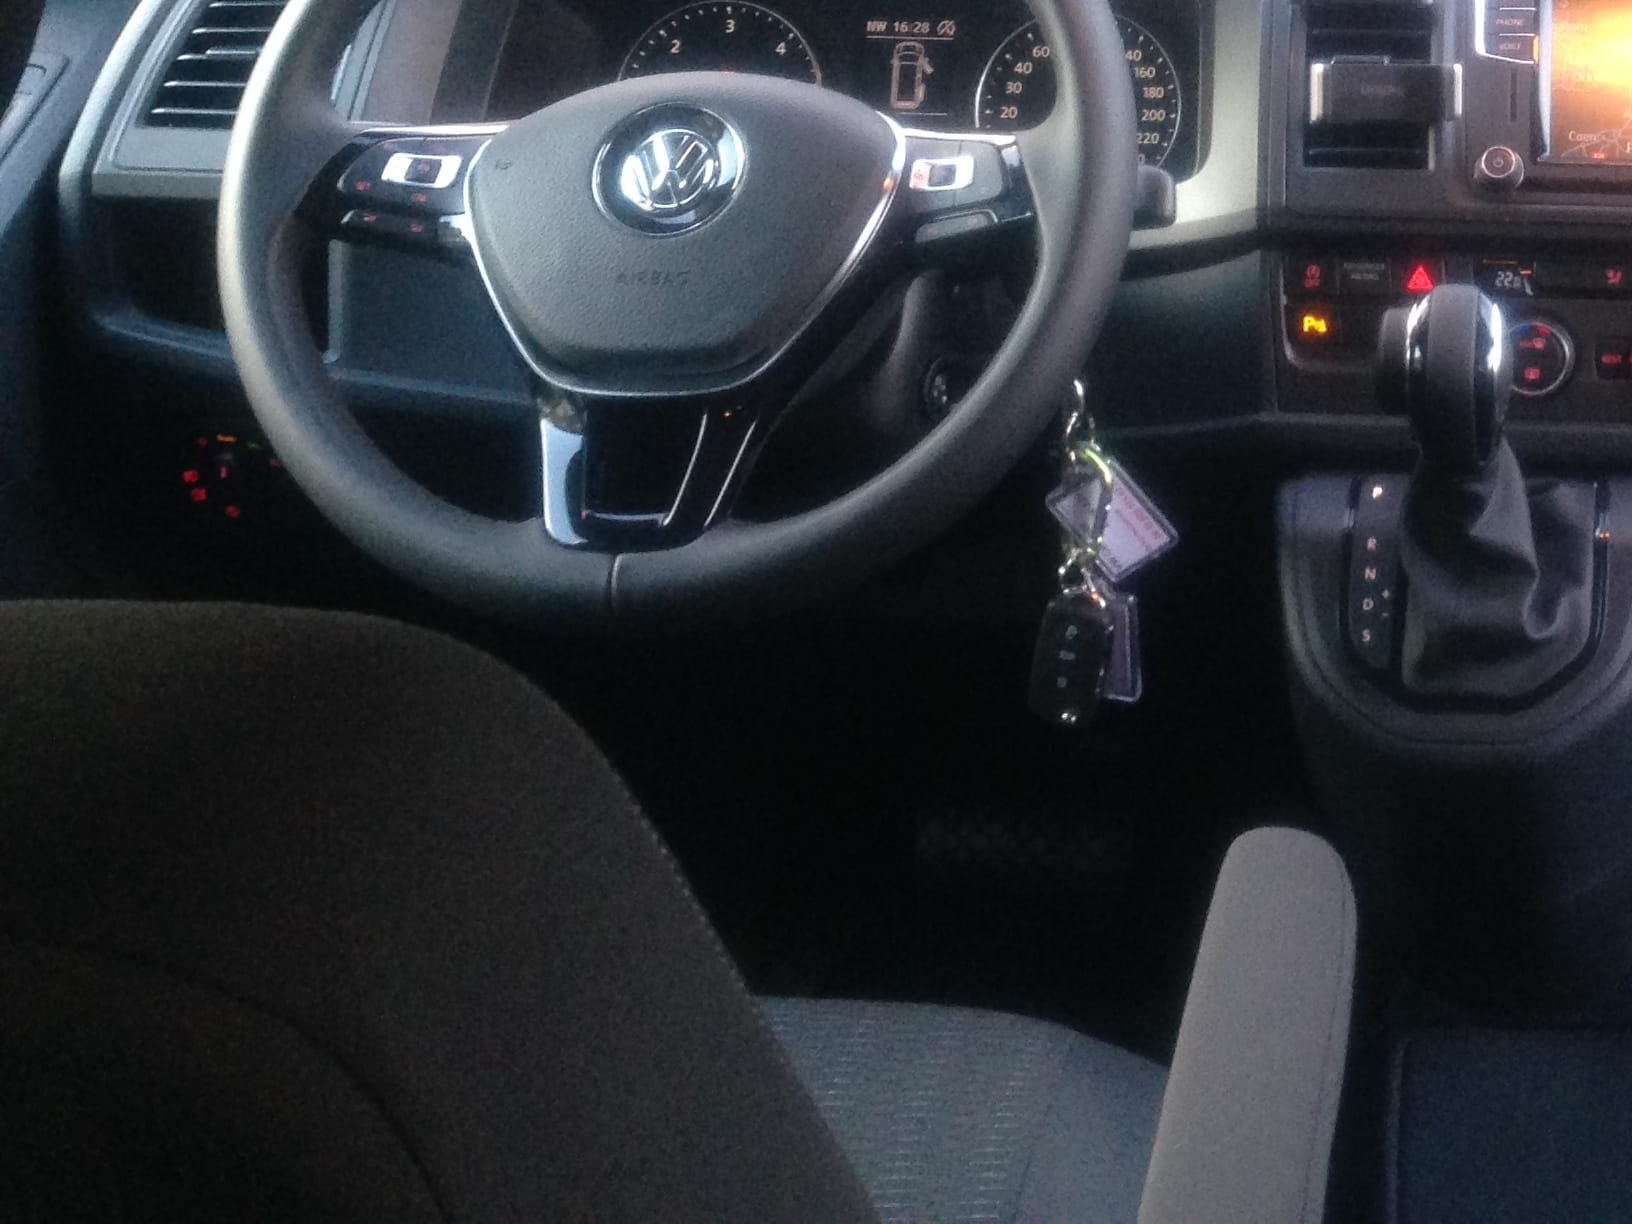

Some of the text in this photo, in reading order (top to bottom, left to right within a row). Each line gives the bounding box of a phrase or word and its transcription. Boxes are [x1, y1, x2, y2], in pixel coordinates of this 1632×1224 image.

[725, 19, 735, 33] 3
[670, 38, 681, 54] 2
[775, 41, 787, 56] 4
[1032, 45, 1050, 58] 60
[1125, 49, 1142, 62] 40
[1014, 61, 1033, 74] 40
[1133, 66, 1156, 79] 160
[1005, 81, 1023, 95] 30
[1142, 86, 1165, 99] 180
[1000, 105, 1018, 119] 20
[1141, 108, 1166, 122] 200
[1372, 485, 1383, 499] P
[1366, 536, 1376, 551] R
[1364, 567, 1377, 581] N
[1362, 598, 1373, 611] D
[1361, 630, 1370, 643] S
